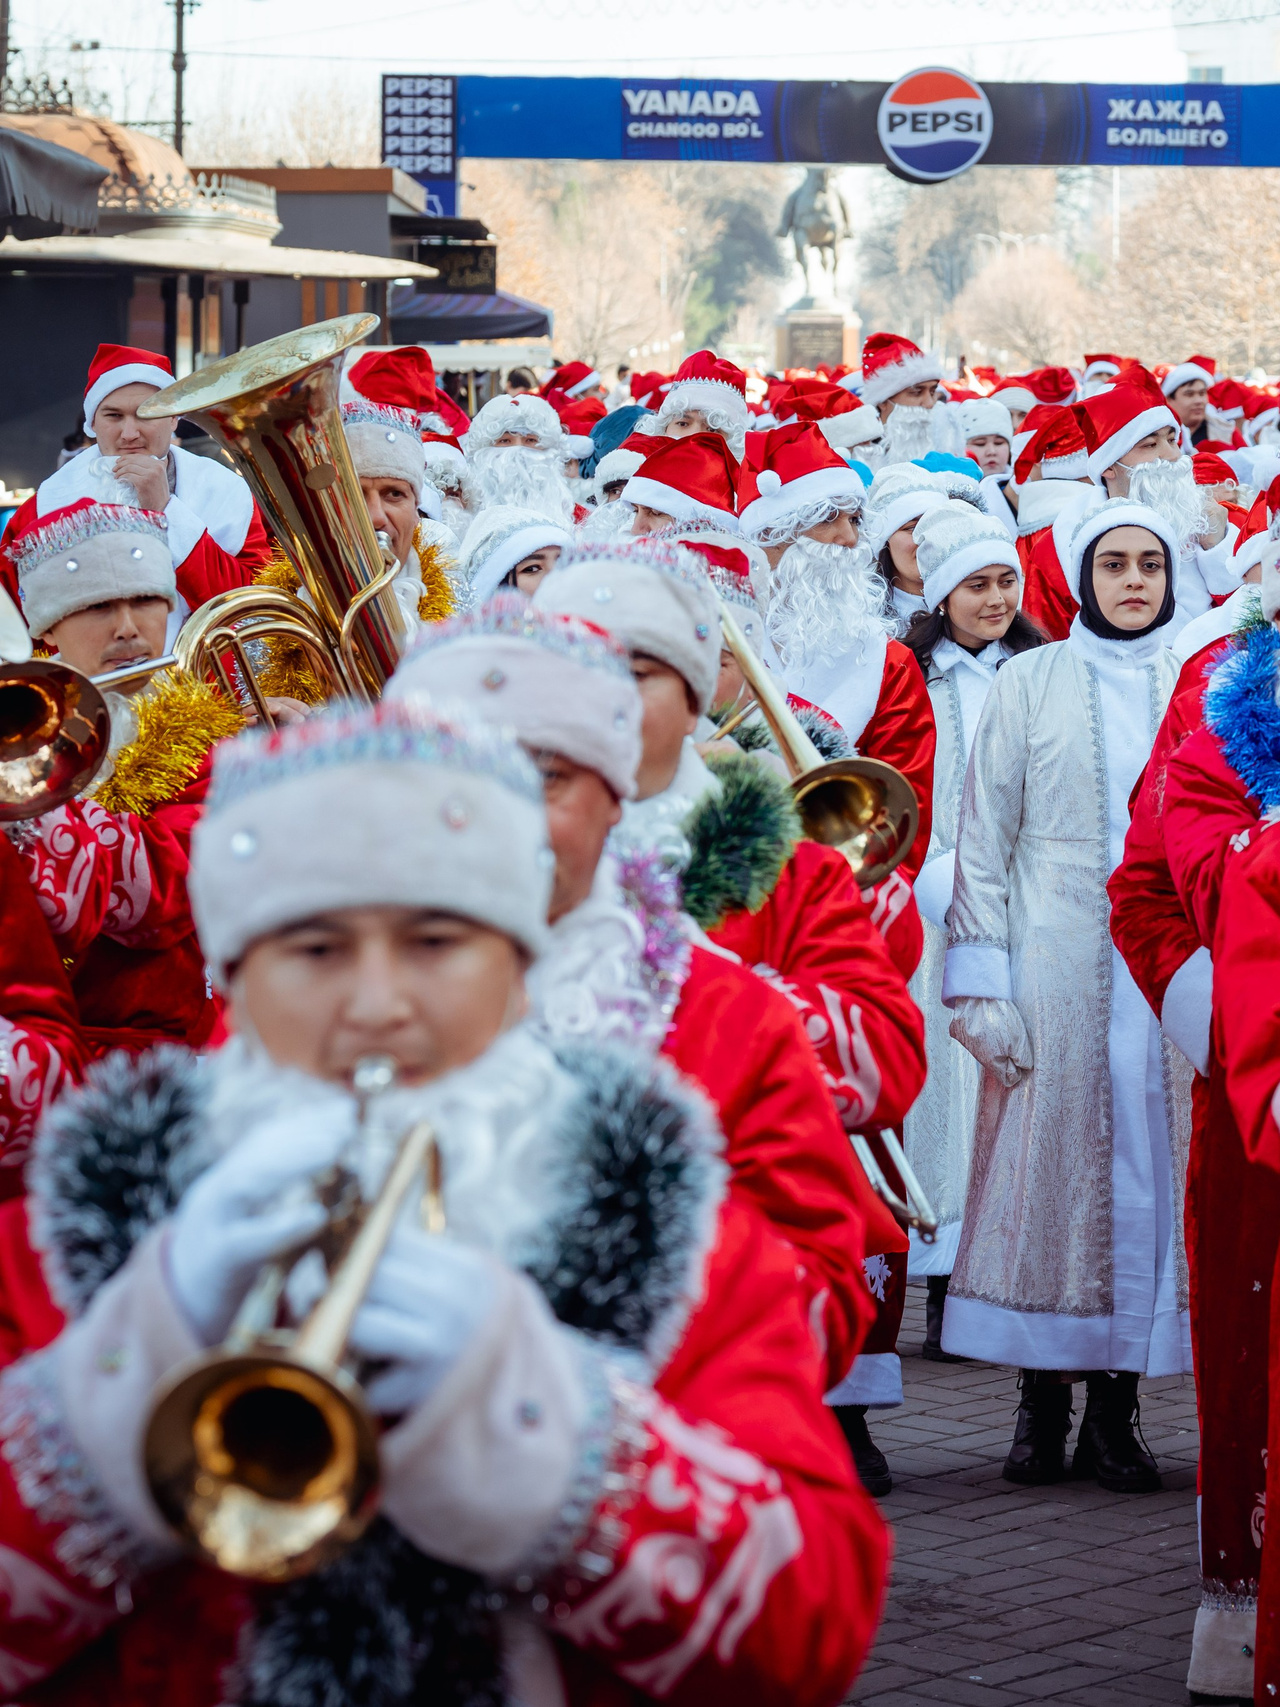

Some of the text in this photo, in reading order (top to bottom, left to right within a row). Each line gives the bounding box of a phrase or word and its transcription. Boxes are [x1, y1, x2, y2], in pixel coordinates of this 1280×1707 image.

[385, 77, 452, 96] PEPSI
[385, 97, 452, 115] PEPSI
[622, 89, 762, 116] YANADA
[1107, 99, 1225, 126] ЖАЖДА
[385, 116, 452, 135] PEPSI
[888, 111, 983, 132] PEPSI
[385, 135, 452, 154] PEPSI
[1107, 127, 1228, 148] БОЛЬШЕГО
